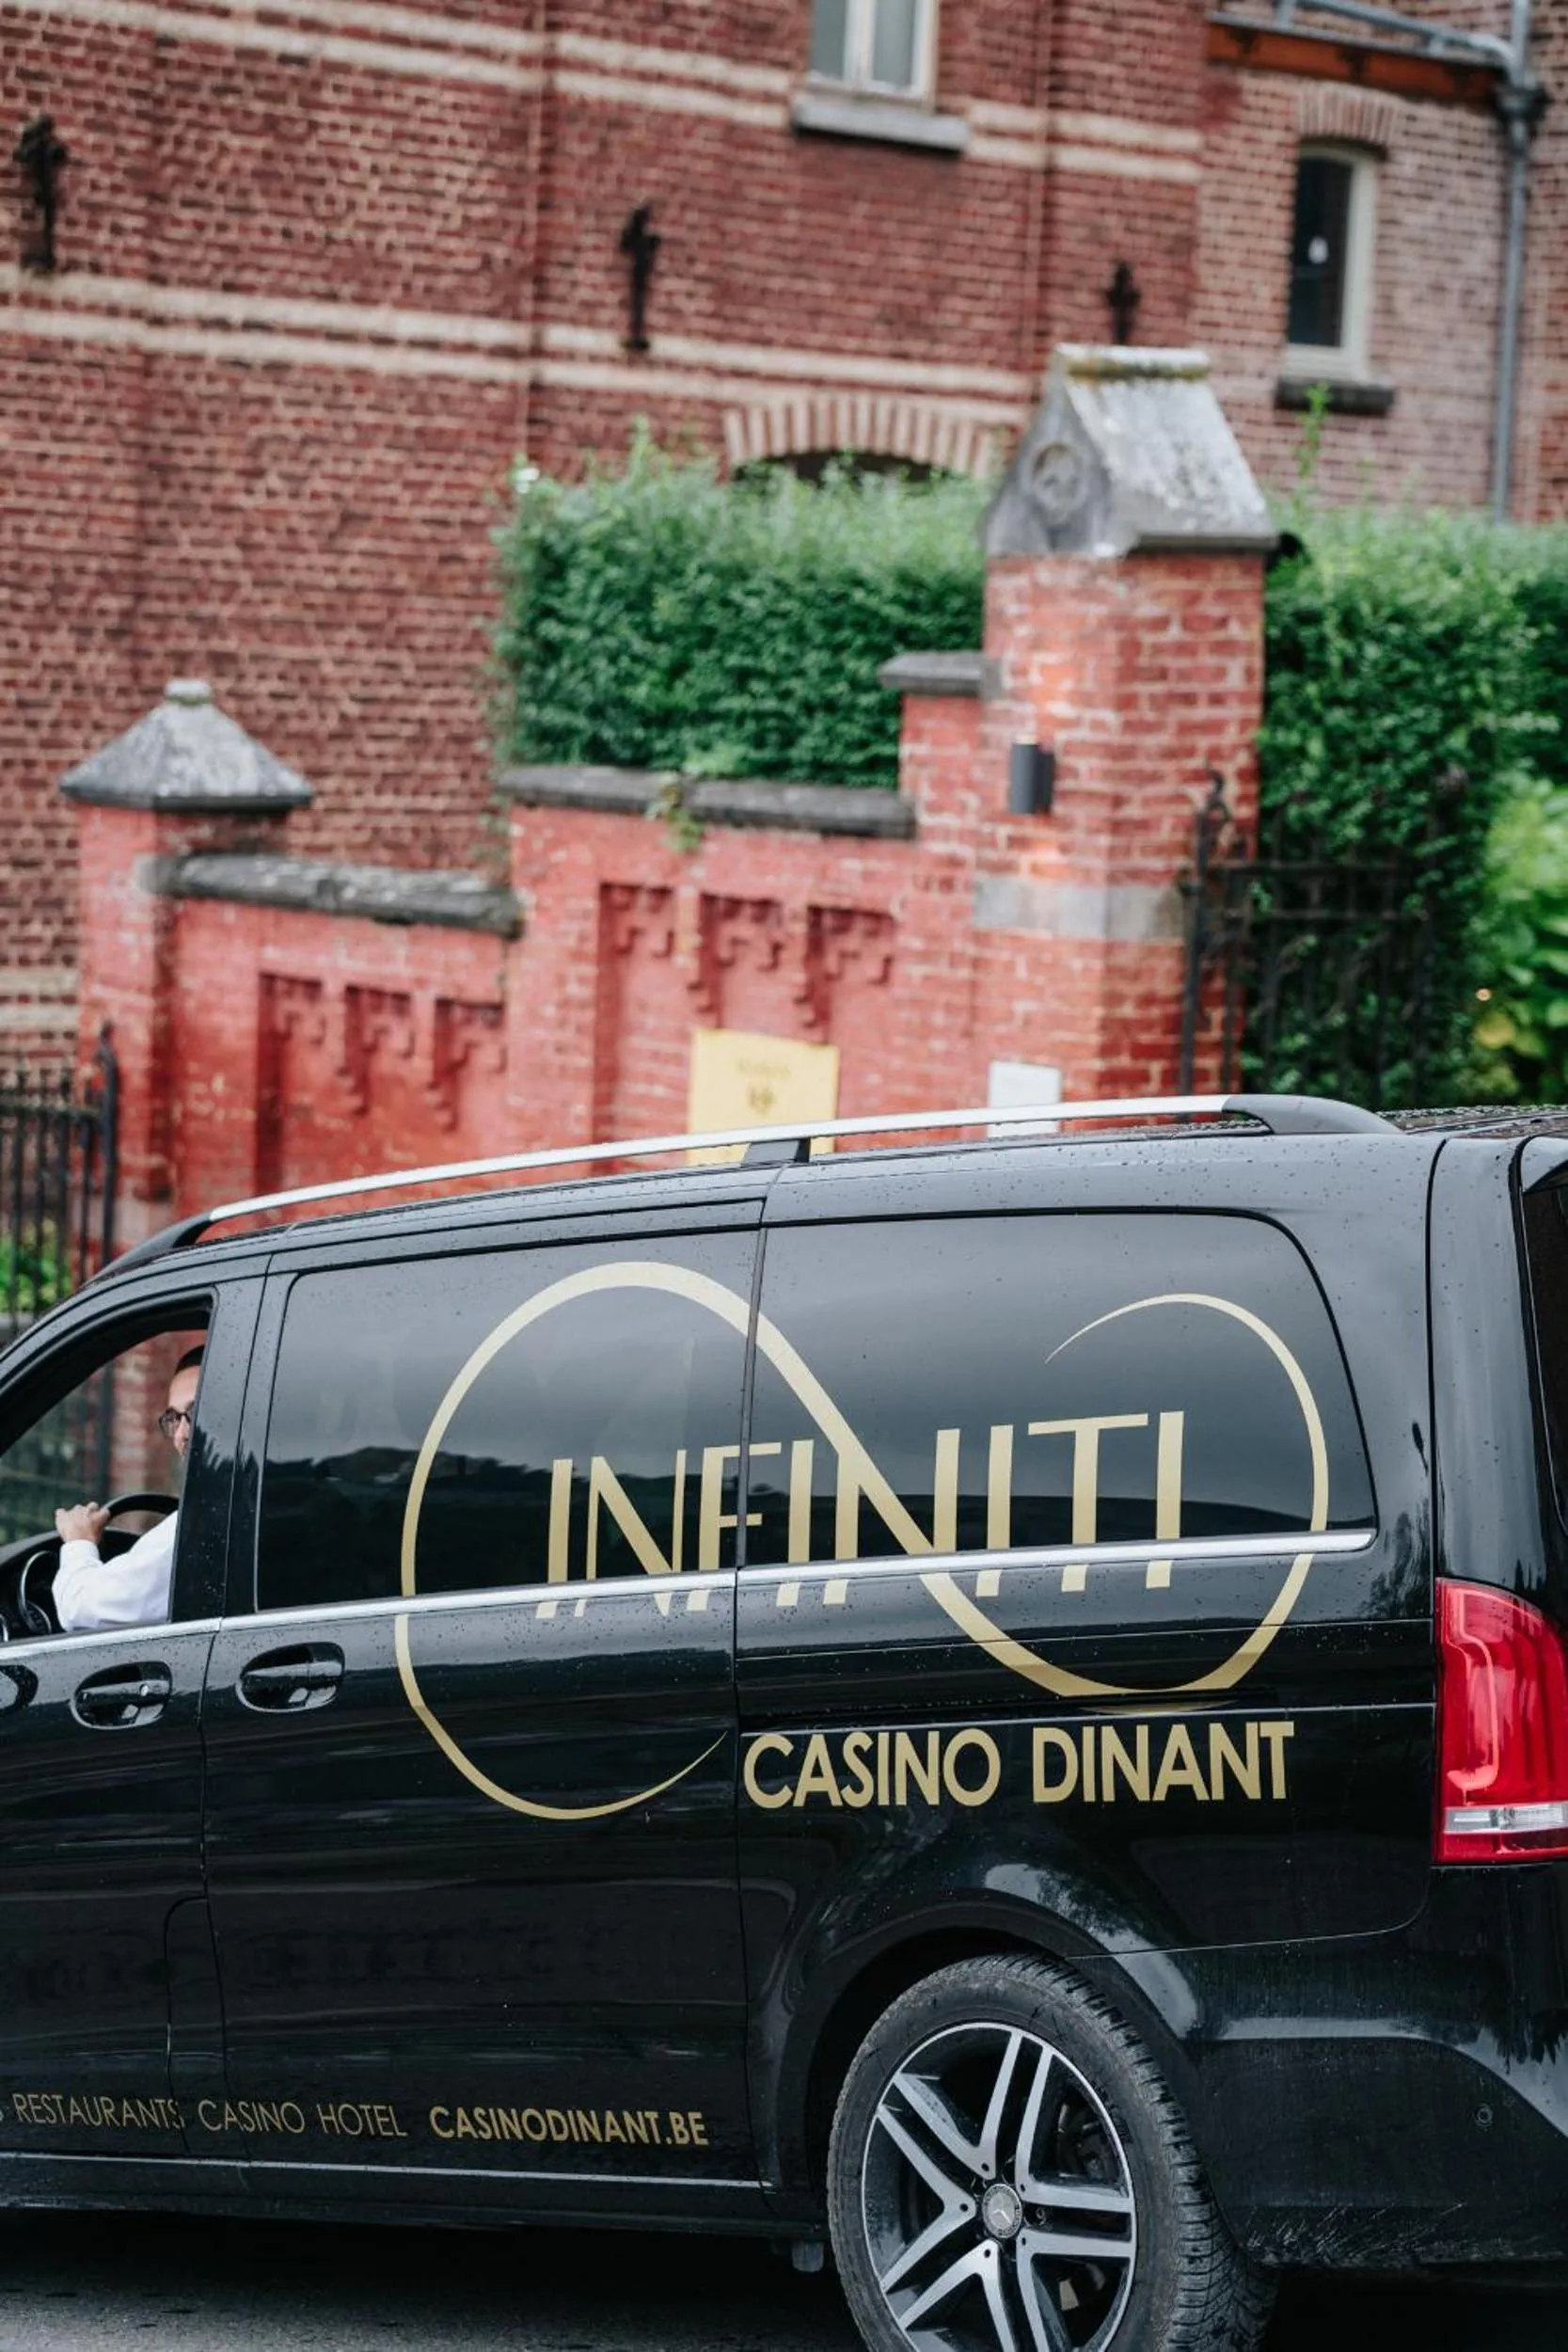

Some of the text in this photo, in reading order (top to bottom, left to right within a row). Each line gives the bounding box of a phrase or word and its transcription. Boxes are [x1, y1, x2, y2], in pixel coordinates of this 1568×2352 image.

[536, 1411, 1185, 1619] INFINITI
[743, 1721, 1295, 1809] CASINO DINANT
[11, 2092, 710, 2146] RESTAURANTS CASINO HOTEL CASINODINANT.BE
